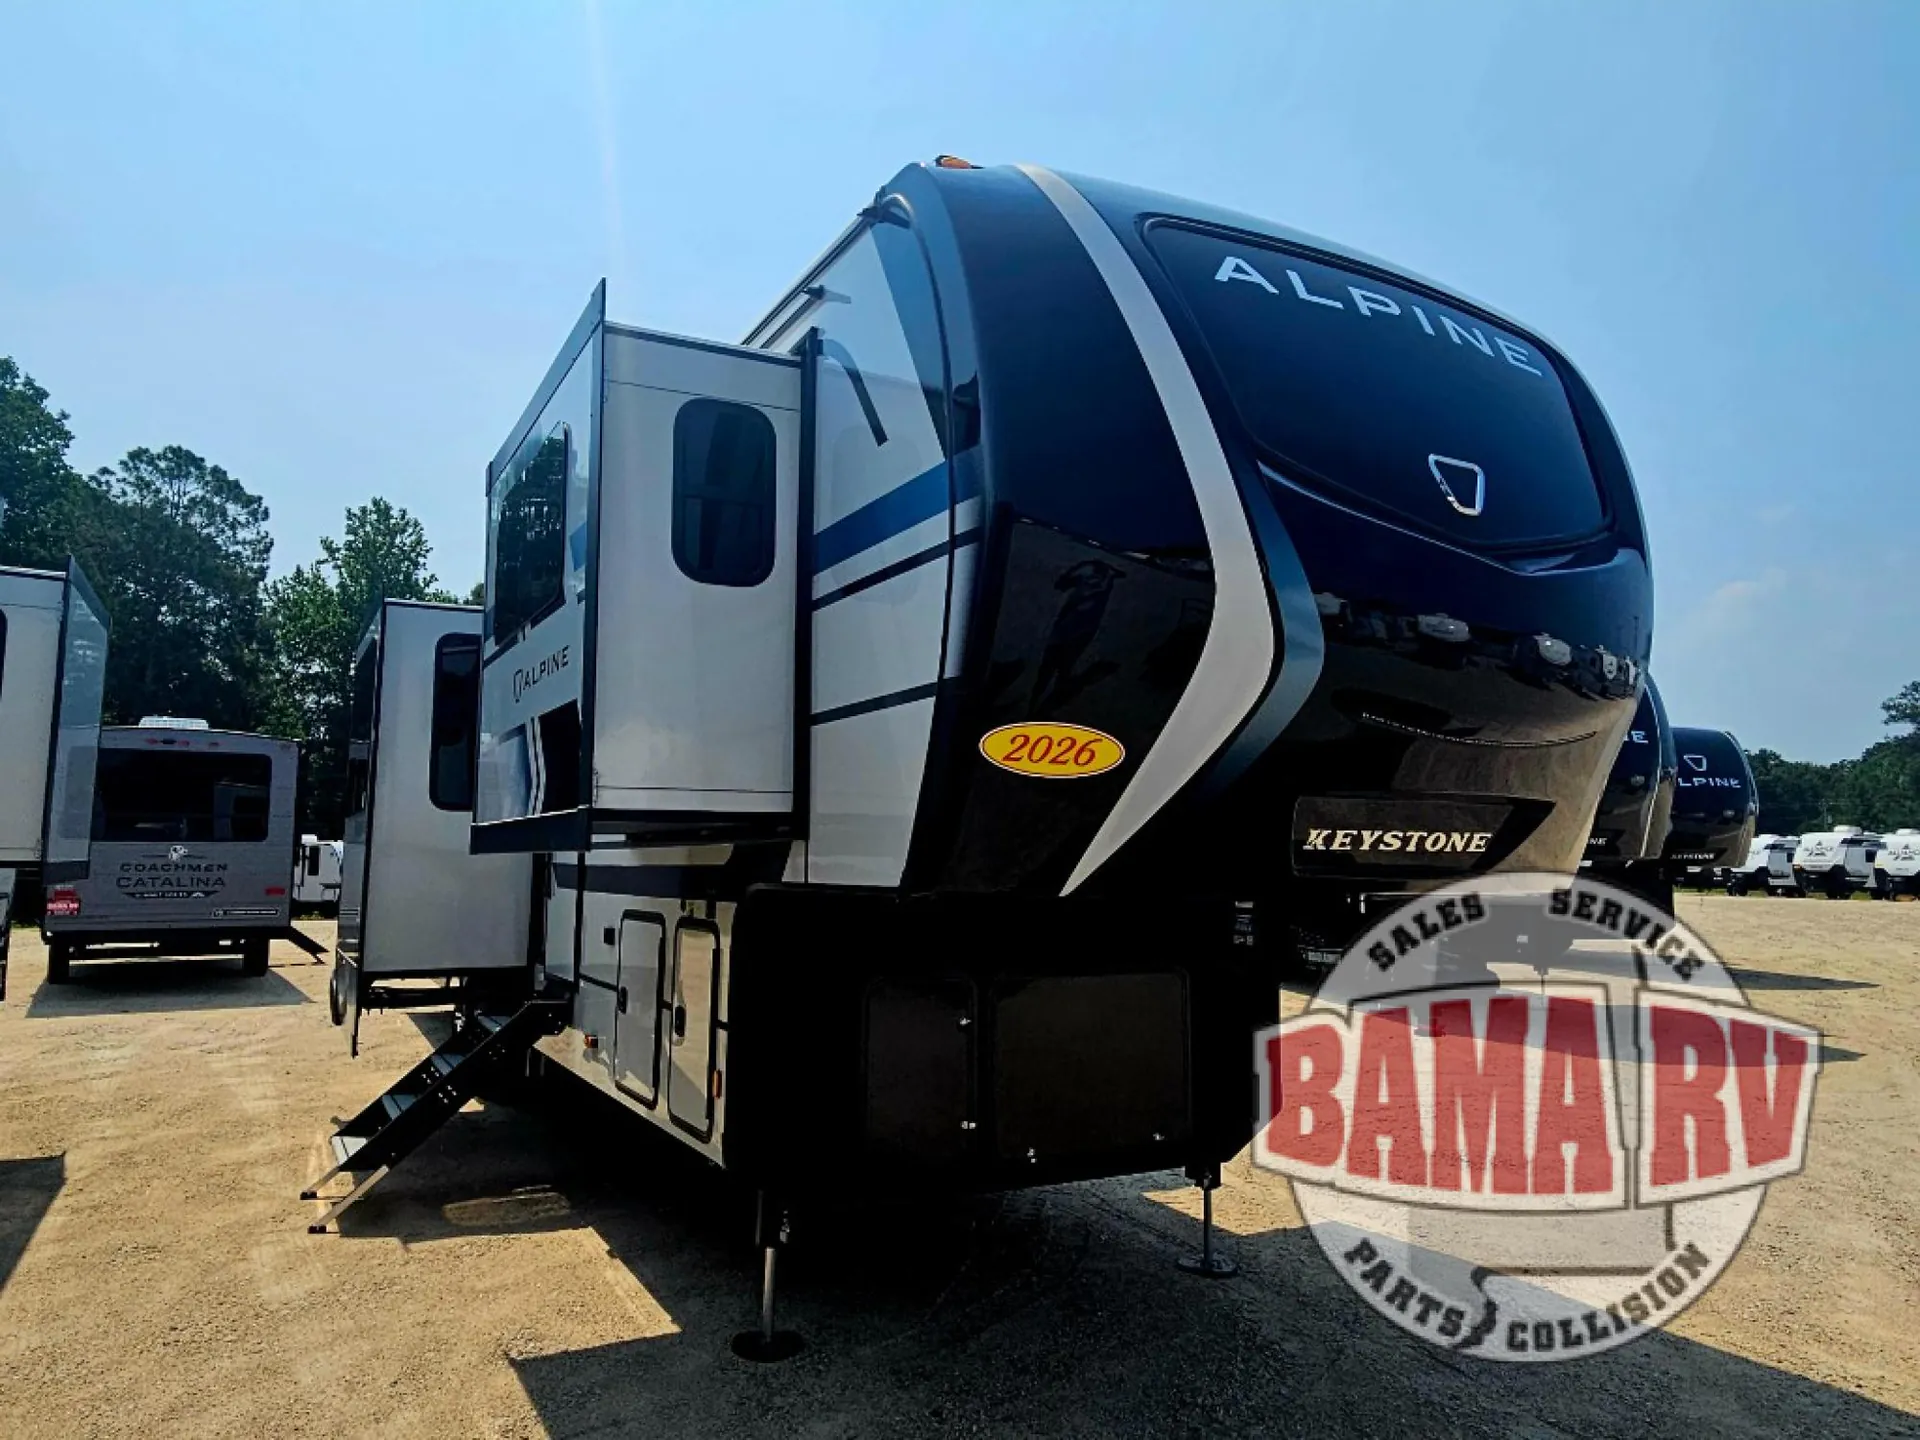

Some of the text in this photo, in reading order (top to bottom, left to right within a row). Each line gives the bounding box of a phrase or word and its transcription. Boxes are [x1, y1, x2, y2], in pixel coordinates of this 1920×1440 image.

[1214, 256, 1542, 376] ALPINE
[523, 645, 570, 690] ALPINE
[1002, 734, 1102, 767] 2026
[1677, 777, 1742, 788] LPINE
[1303, 828, 1492, 853] KEYSTONE
[119, 863, 228, 873] COACHMEN
[116, 876, 226, 889] CATALINA
